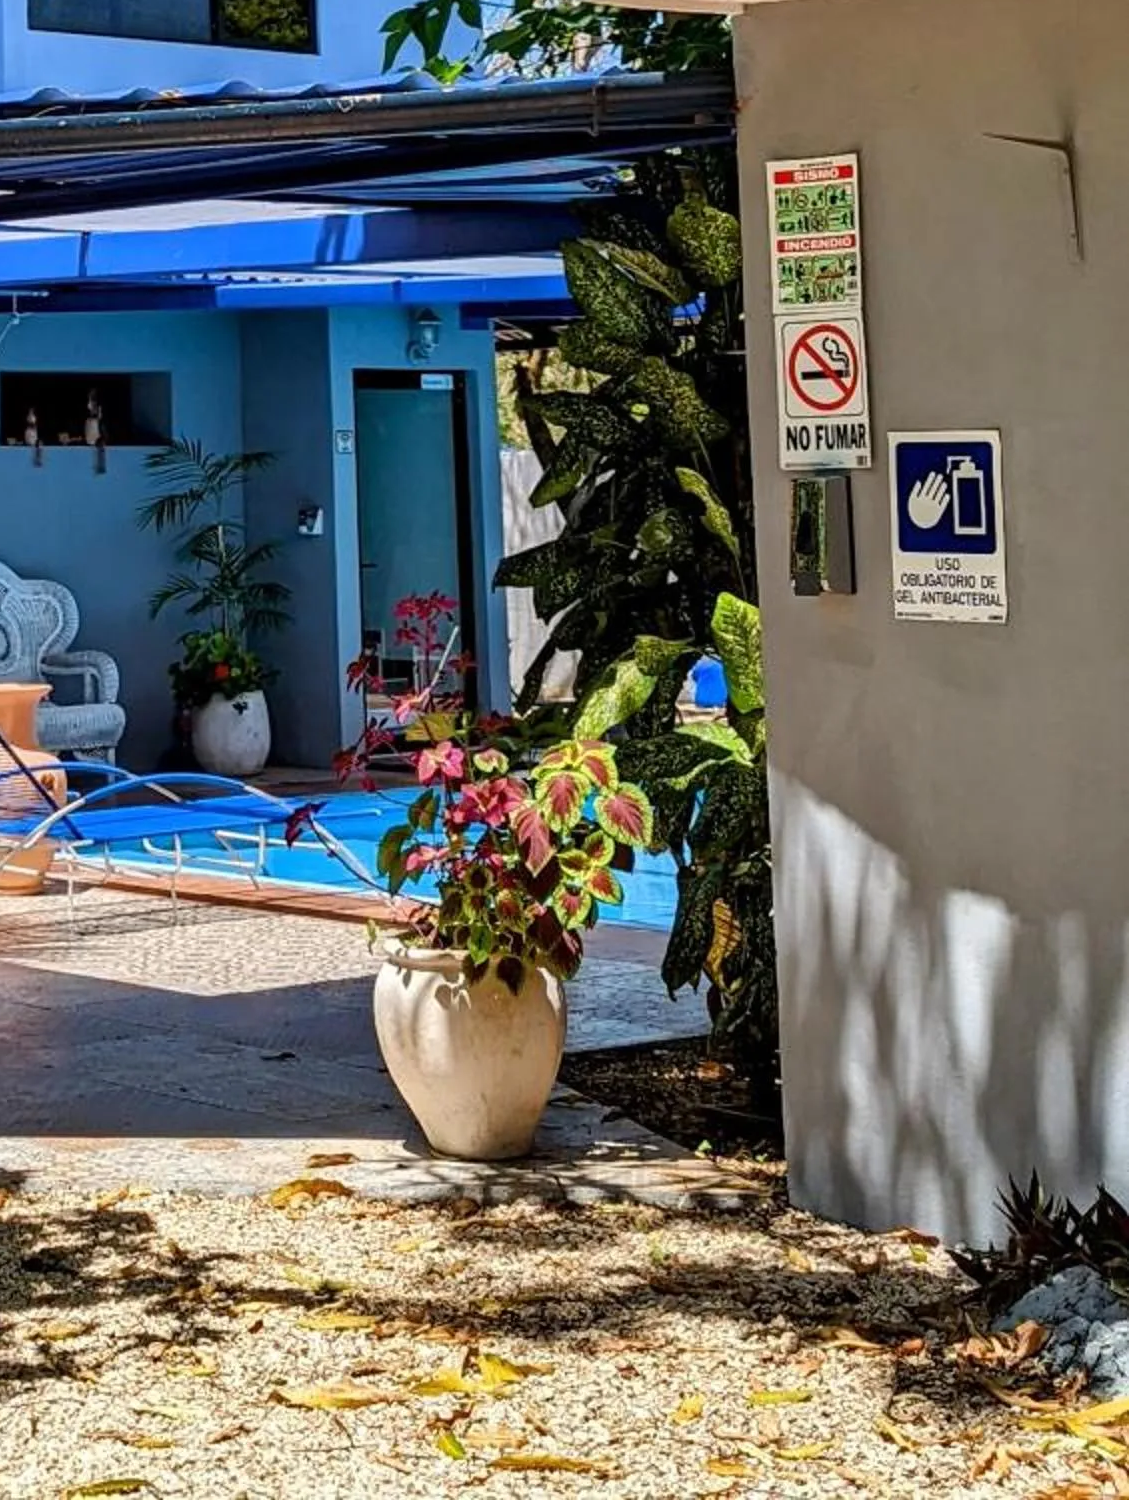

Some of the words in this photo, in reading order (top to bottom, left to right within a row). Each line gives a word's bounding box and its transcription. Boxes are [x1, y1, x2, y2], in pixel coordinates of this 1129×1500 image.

[793, 167, 839, 183] SISMO
[784, 237, 852, 251] INCENDIO
[786, 425, 810, 451] NO
[815, 423, 867, 450] FUMAR
[935, 557, 960, 571] USO
[900, 573, 976, 589] OBLIGATORIO
[981, 575, 998, 589] DE
[896, 589, 917, 604] GEL
[920, 591, 1004, 607] ANTIBACTERIAL
